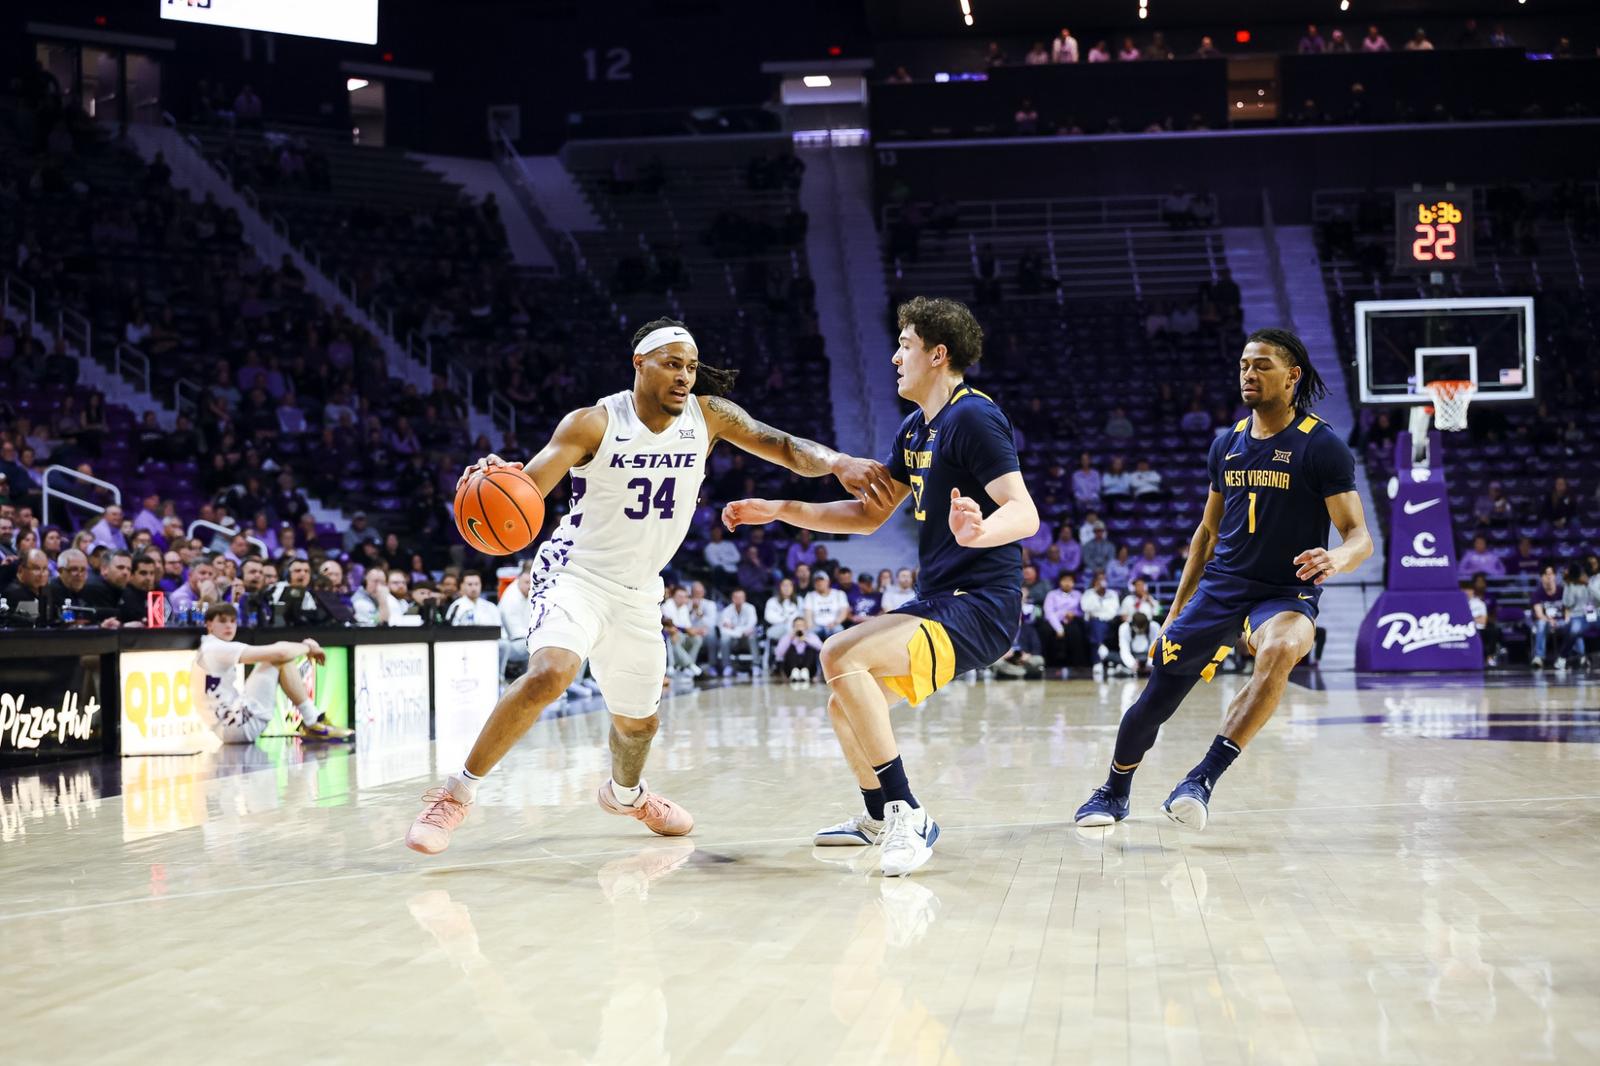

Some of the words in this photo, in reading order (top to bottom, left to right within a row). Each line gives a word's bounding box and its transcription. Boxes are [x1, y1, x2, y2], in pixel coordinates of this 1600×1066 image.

[583, 48, 632, 80] 12
[1419, 201, 1462, 224] 6:36
[1413, 224, 1456, 260] 22
[609, 453, 697, 469] K-STATE
[1225, 470, 1246, 487] WEST
[1247, 470, 1291, 490] VIRGINIA
[624, 477, 676, 520] 34
[1248, 492, 1257, 534] 1
[1376, 611, 1477, 654] Dillons
[0, 692, 57, 750] Pizza
[57, 690, 101, 745] Hut
[124, 670, 193, 738] QDO
